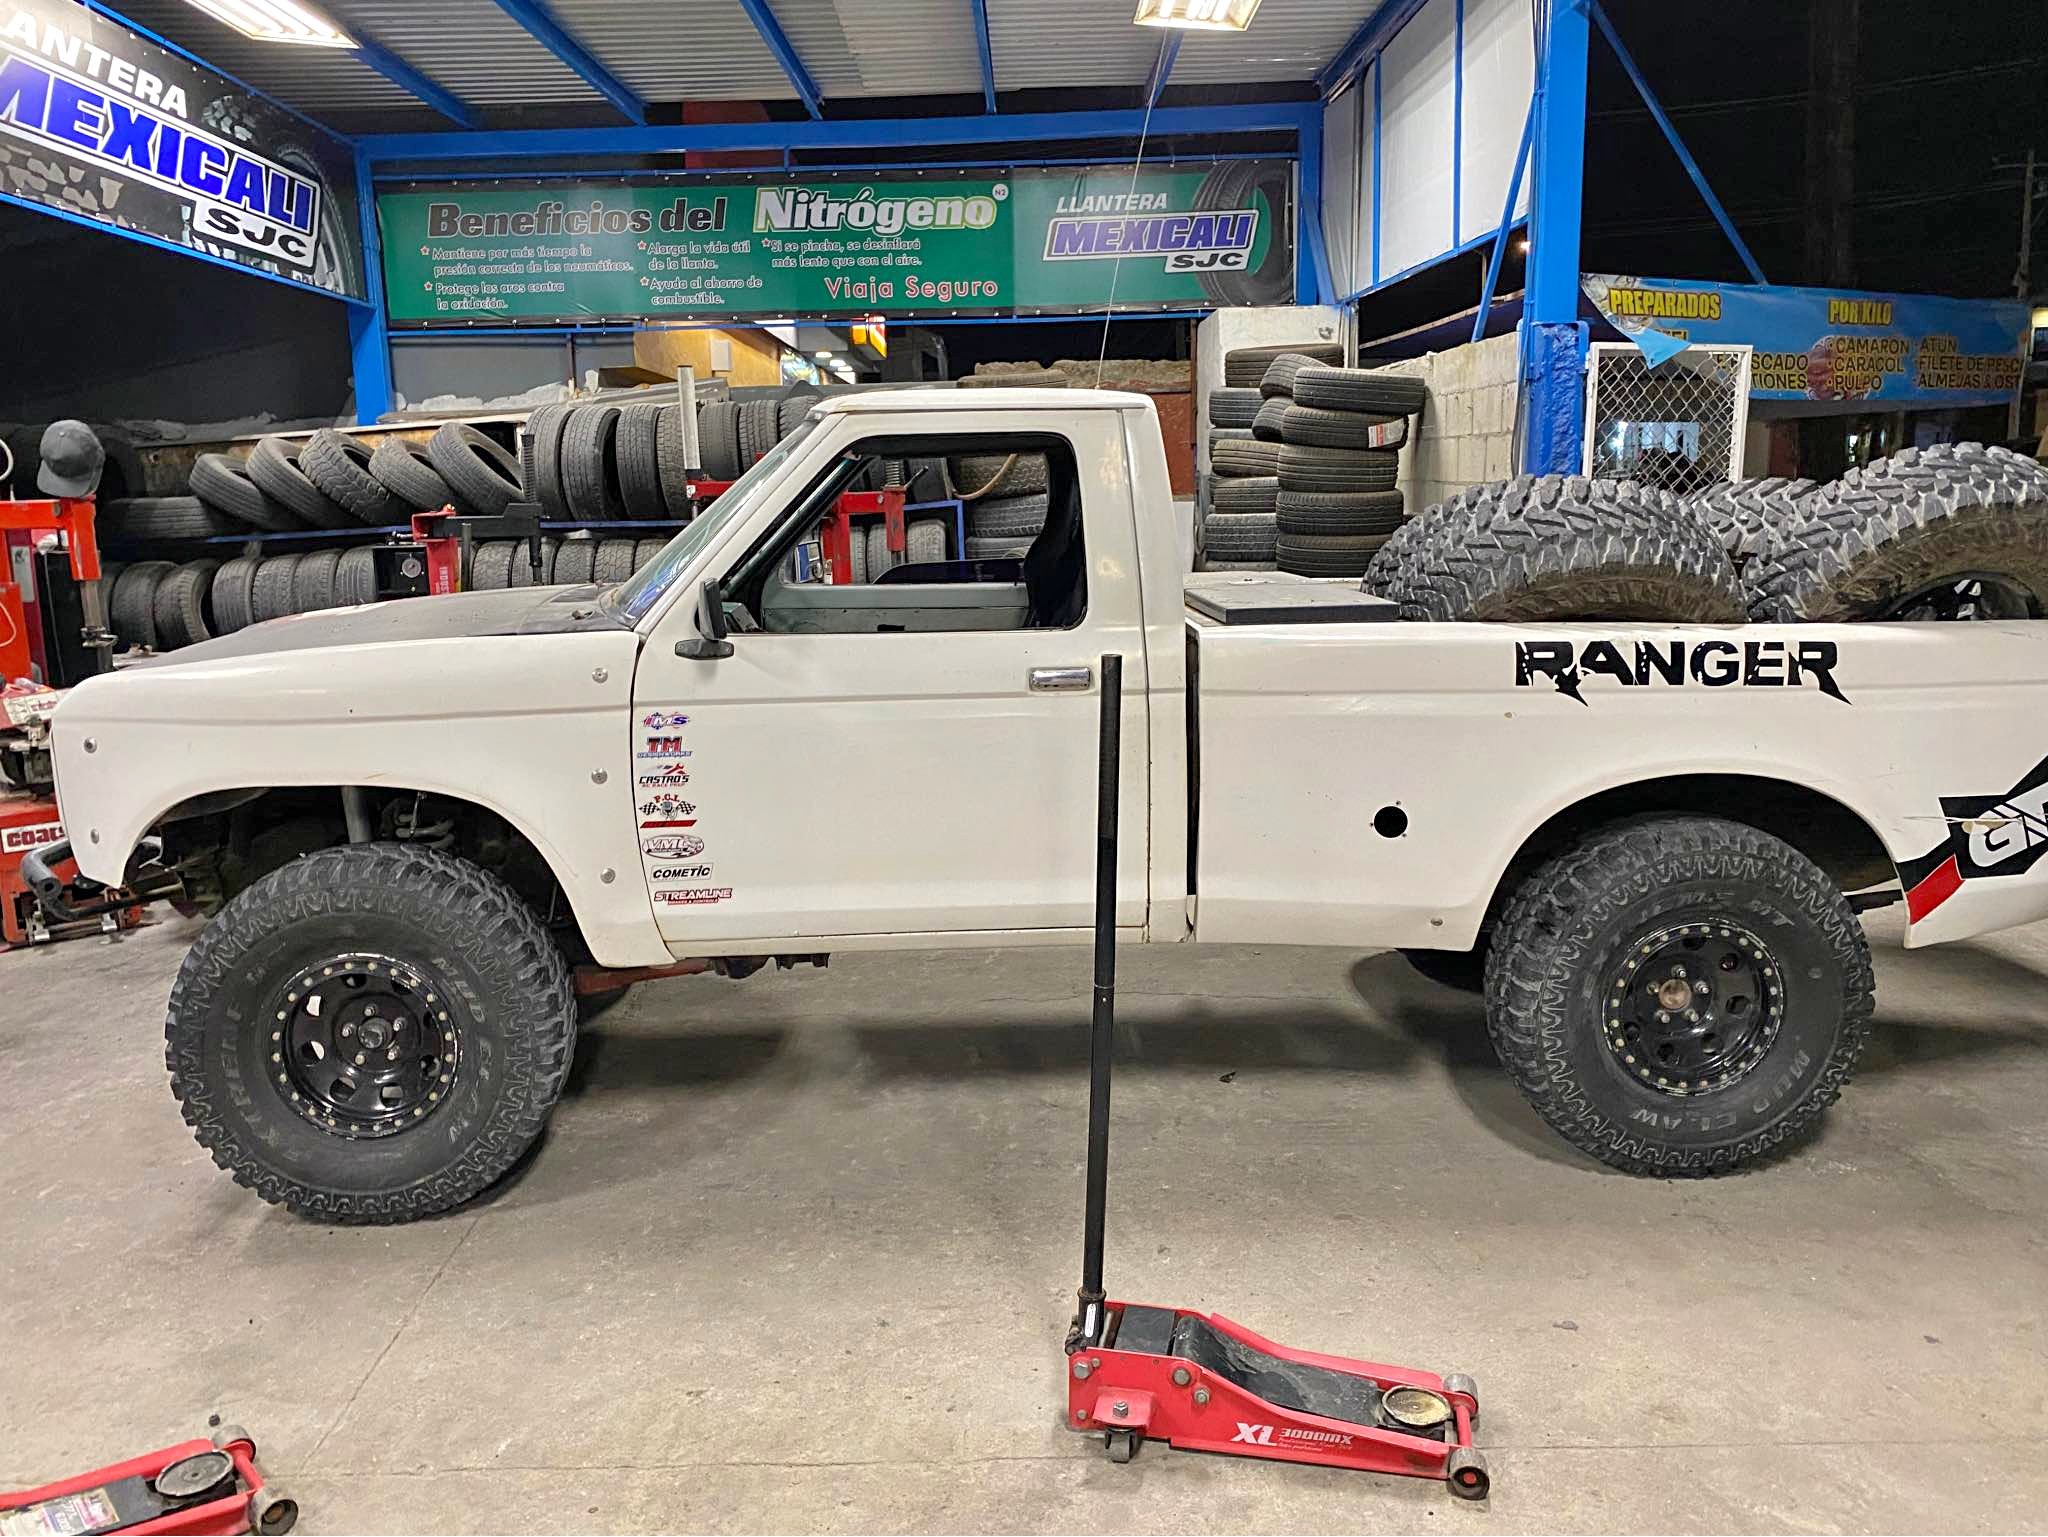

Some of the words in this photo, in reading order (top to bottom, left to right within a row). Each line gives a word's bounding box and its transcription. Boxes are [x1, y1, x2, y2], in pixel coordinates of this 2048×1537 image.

[1056, 193, 1168, 214] LLANTERA
[428, 200, 652, 239] Beneficios
[659, 197, 728, 233] del
[753, 187, 997, 237] Nitrógeno
[205, 208, 307, 258] SJC
[1052, 215, 1254, 256] MEXICALI
[432, 247, 486, 260] Mantiene
[488, 249, 508, 261] por
[511, 246, 534, 258] más
[537, 245, 577, 259] tiempo
[580, 244, 592, 257] la
[648, 242, 687, 255] Alarga
[689, 241, 701, 253] la
[703, 240, 729, 253] vida
[731, 240, 751, 253] útil
[770, 240, 782, 252] Si
[784, 242, 798, 252] se
[800, 239, 844, 254] pincha,
[847, 241, 861, 250] se
[863, 238, 920, 250] desinflará
[434, 263, 476, 278] presión
[479, 262, 525, 275] correcta
[527, 260, 541, 273] de
[544, 260, 561, 272] los
[564, 260, 634, 272] neumáticos.
[649, 258, 664, 270] de
[666, 258, 679, 270] la
[681, 257, 719, 269] llanta.
[771, 256, 797, 267] más
[800, 255, 829, 266] lento
[831, 256, 855, 269] que
[857, 256, 879, 266] con
[881, 253, 892, 265] el
[895, 254, 922, 265] aire.
[1172, 253, 1243, 269] SJC
[436, 282, 479, 296] Protege
[481, 281, 498, 294] los
[500, 284, 526, 294] aros
[528, 281, 565, 292] contra
[650, 277, 687, 292] Ayuda
[690, 276, 702, 289] al
[705, 276, 744, 289] ahorro
[746, 276, 762, 288] de
[824, 276, 893, 303] Viaja
[905, 276, 998, 302] Seguro
[437, 298, 448, 310] la
[451, 297, 509, 310] oxidación.
[651, 293, 725, 305] combustible.
[1609, 288, 1721, 320] PREPARADOS
[1829, 299, 1858, 324] POR
[1861, 301, 1892, 325] KILO
[1750, 353, 1808, 370] SCADO
[1835, 356, 1905, 372] CARACOL
[1919, 356, 1964, 371] FILETE
[1967, 357, 1983, 371] DE
[1986, 358, 2024, 373] PESC
[1750, 372, 1807, 390] TIONES
[1836, 374, 1882, 390] PULPO
[1918, 373, 1981, 388] ALMEJAS
[1515, 640, 1852, 707] RANGER
[654, 888, 733, 902] STREAMLINE
[1230, 1422, 1278, 1447] XL
